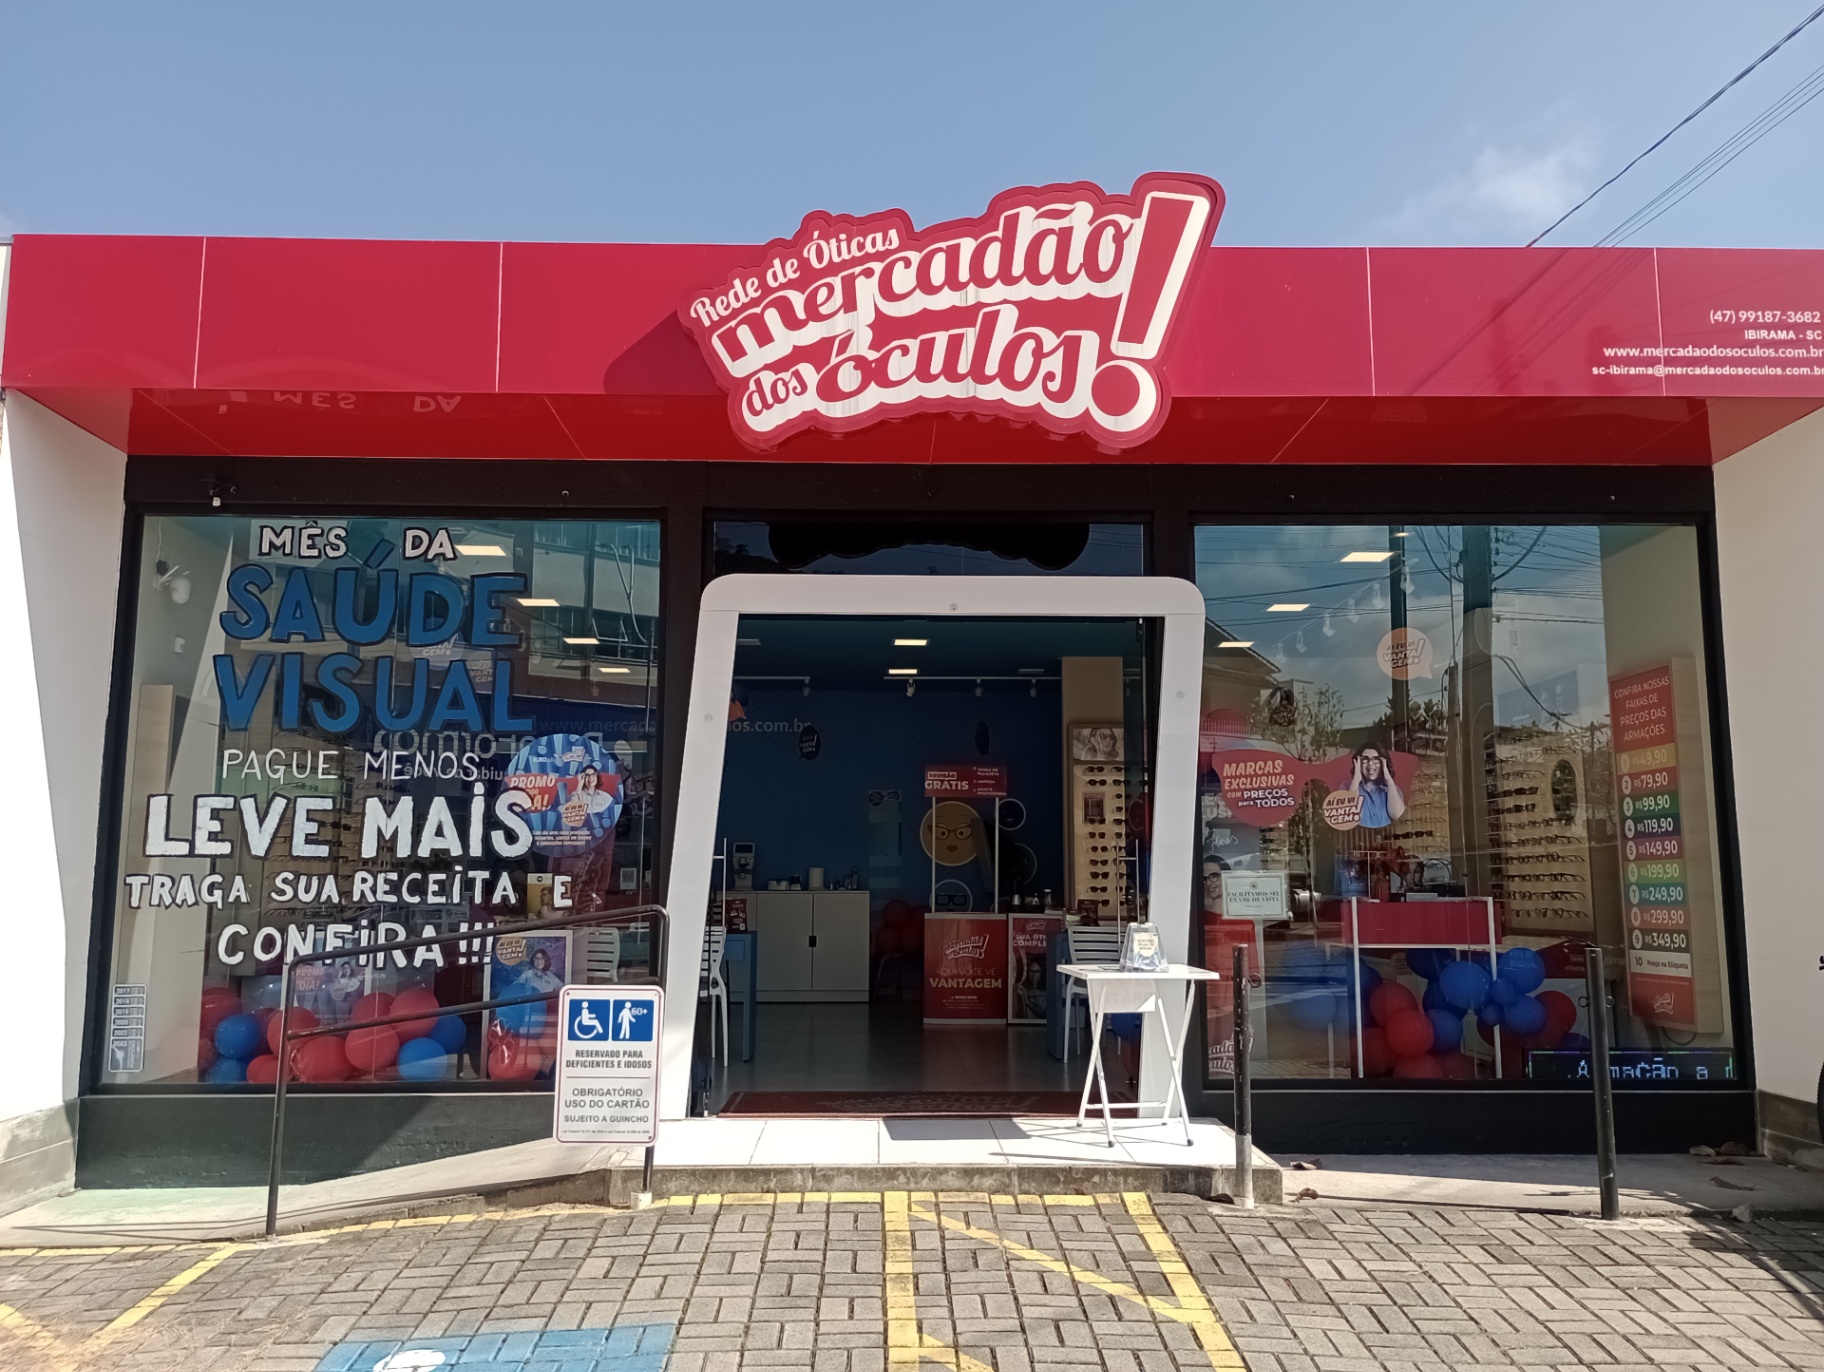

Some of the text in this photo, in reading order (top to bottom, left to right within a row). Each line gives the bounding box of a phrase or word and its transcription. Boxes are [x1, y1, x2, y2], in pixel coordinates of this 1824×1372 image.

[690, 228, 900, 327] Rede de Óticas
[1710, 310, 1822, 324] (47) 99187-3682
[1744, 329, 1797, 341] IBIRAMA
[1806, 329, 1823, 341] SC
[1603, 345, 1824, 359] www.mercadaodosoculos.com.br
[748, 362, 809, 418] dos
[260, 520, 457, 562] MÊS DA
[219, 538, 528, 647] SAÚDE
[212, 652, 536, 734] VISUAL
[1614, 675, 1670, 699] CONFIRA NOSSAS
[1625, 692, 1659, 710] FAIXAS DE
[1620, 706, 1667, 727] PREÇOS DAS
[1623, 723, 1666, 742] ARMAÇÕES
[220, 747, 481, 788] PAGUE MENOS
[1222, 759, 1284, 777] MARCAS
[510, 775, 557, 789] PROMO
[924, 779, 969, 791] GRÁTIS
[1224, 773, 1295, 790] EXCLUSIVAS
[1242, 788, 1288, 799] PREÇOS
[1254, 797, 1295, 808] TODOS
[1326, 797, 1335, 807] AÍ
[1347, 796, 1356, 804] VI
[144, 793, 332, 859] LEVE
[125, 874, 248, 908] TRAGA
[270, 872, 347, 904] SUA
[553, 875, 574, 908] E
[1013, 939, 1047, 947] COMPLE
[1634, 956, 1643, 967] 10
[1647, 959, 1661, 969] Preço
[1667, 960, 1689, 971] Etiqueta
[935, 967, 957, 977] AQUI
[959, 966, 983, 976] VOCÊ
[928, 977, 1002, 989] VANTAGEM
[630, 1007, 648, 1017] 60+
[575, 1049, 644, 1059] RESERVADO PARA
[565, 1060, 652, 1069] DEFICIENTES E IDOSOS
[572, 1086, 644, 1098] OBRIGATÓRIO
[564, 1098, 650, 1110] USO DO CARTÃO
[564, 1114, 649, 1124] SUJEITO A GUINCHO
